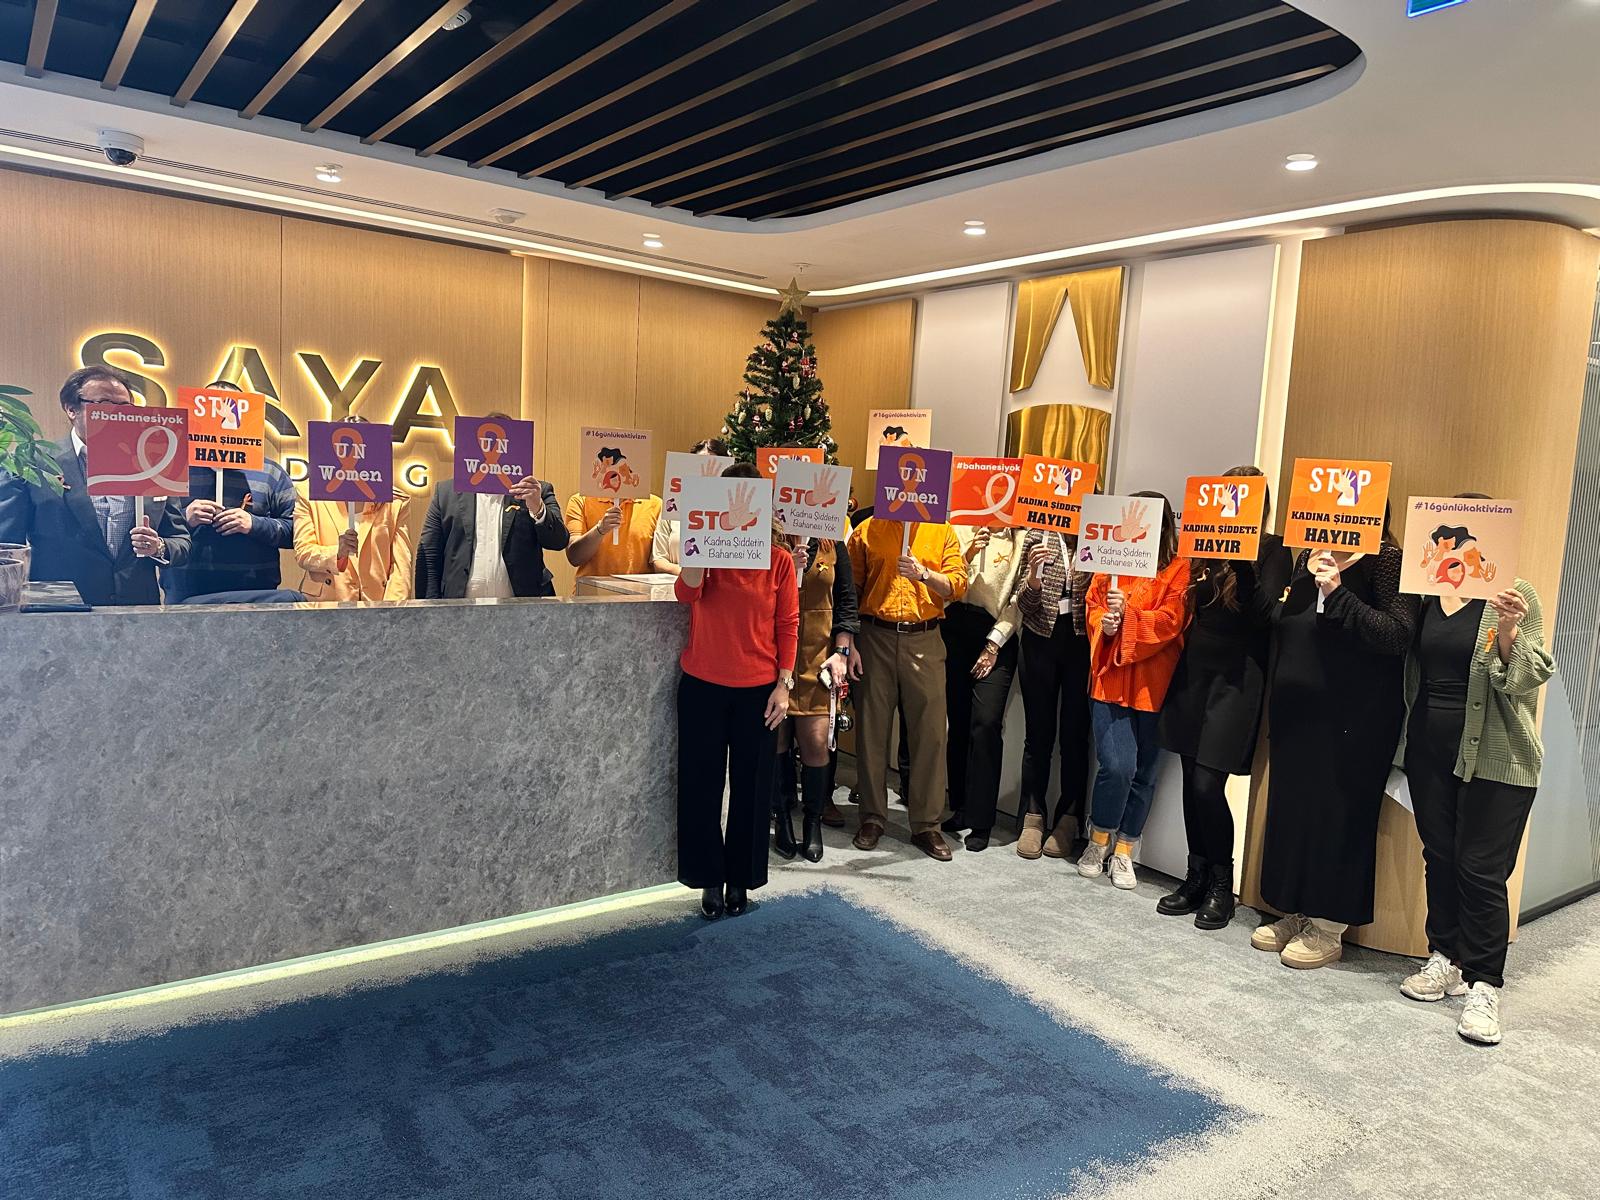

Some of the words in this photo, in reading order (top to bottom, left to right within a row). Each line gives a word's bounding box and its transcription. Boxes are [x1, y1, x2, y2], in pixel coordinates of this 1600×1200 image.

[81, 333, 457, 443] SAYA
[90, 410, 184, 426] #bahanesiyok
[188, 434, 217, 443] ADINA
[220, 434, 262, 446] ŞİDDETE
[195, 448, 246, 464] HAYIR
[318, 465, 383, 483] Women
[464, 458, 523, 476] Women
[956, 462, 1021, 473] #bahanesiyok
[884, 486, 939, 504] Women
[1018, 496, 1048, 508] KADINA
[1051, 501, 1082, 513] ŞİDDET
[1414, 502, 1512, 514] #16günlükaktivizm
[1027, 510, 1072, 528] HAYIR
[1291, 511, 1330, 522] KADINA
[1334, 512, 1381, 526] ŞİDDETE
[1183, 524, 1215, 533] KADINA
[1218, 523, 1258, 535] ŞİDDETE
[1304, 528, 1361, 546] HAYIR
[708, 548, 744, 560] Bahanesi
[746, 550, 762, 560] Yok
[1194, 538, 1240, 554] HAYIR
